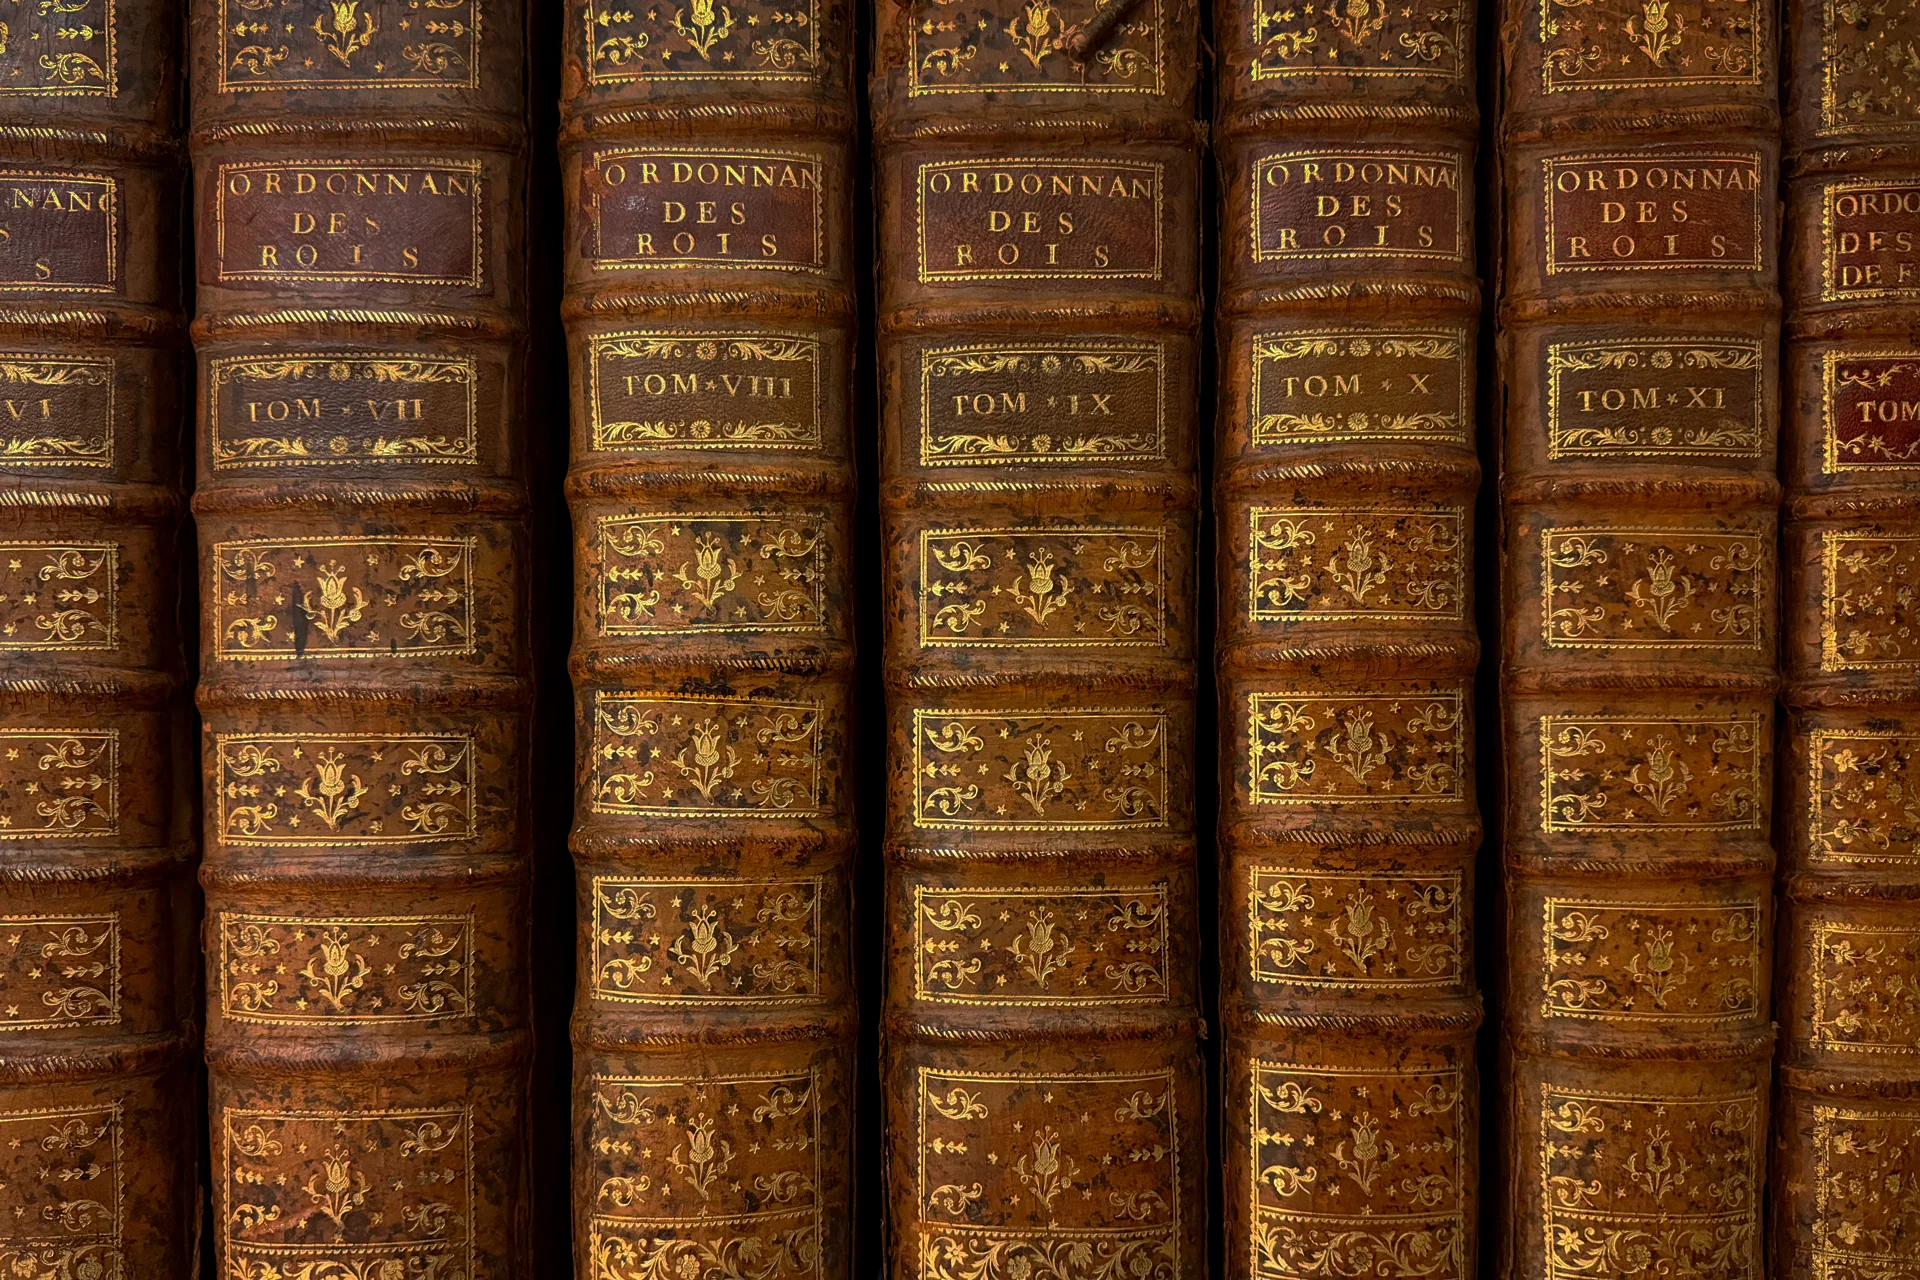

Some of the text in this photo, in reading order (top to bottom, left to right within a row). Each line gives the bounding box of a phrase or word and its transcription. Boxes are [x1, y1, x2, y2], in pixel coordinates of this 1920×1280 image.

[605, 162, 821, 191] ORDONNAN
[1557, 167, 1760, 193] ORDONNAN
[663, 201, 746, 225] DES
[1315, 195, 1402, 218] DES
[1600, 200, 1688, 224] DES
[292, 212, 381, 236] DES
[988, 210, 1074, 235] DES
[635, 232, 777, 257] ROIS
[1277, 225, 1433, 250] ROIS
[1566, 234, 1726, 259] ROIS
[1838, 231, 1913, 255] DES
[259, 244, 418, 269] ROIS
[954, 244, 1109, 268] ROIS
[1842, 264, 1882, 286] DE
[622, 373, 794, 398] TOM VIII
[1280, 373, 1433, 397] TOM X
[247, 398, 425, 422] TOM VII
[952, 392, 1116, 416] TOM IX
[1575, 386, 1726, 412] TOM XI
[1856, 400, 1920, 422] TOM
